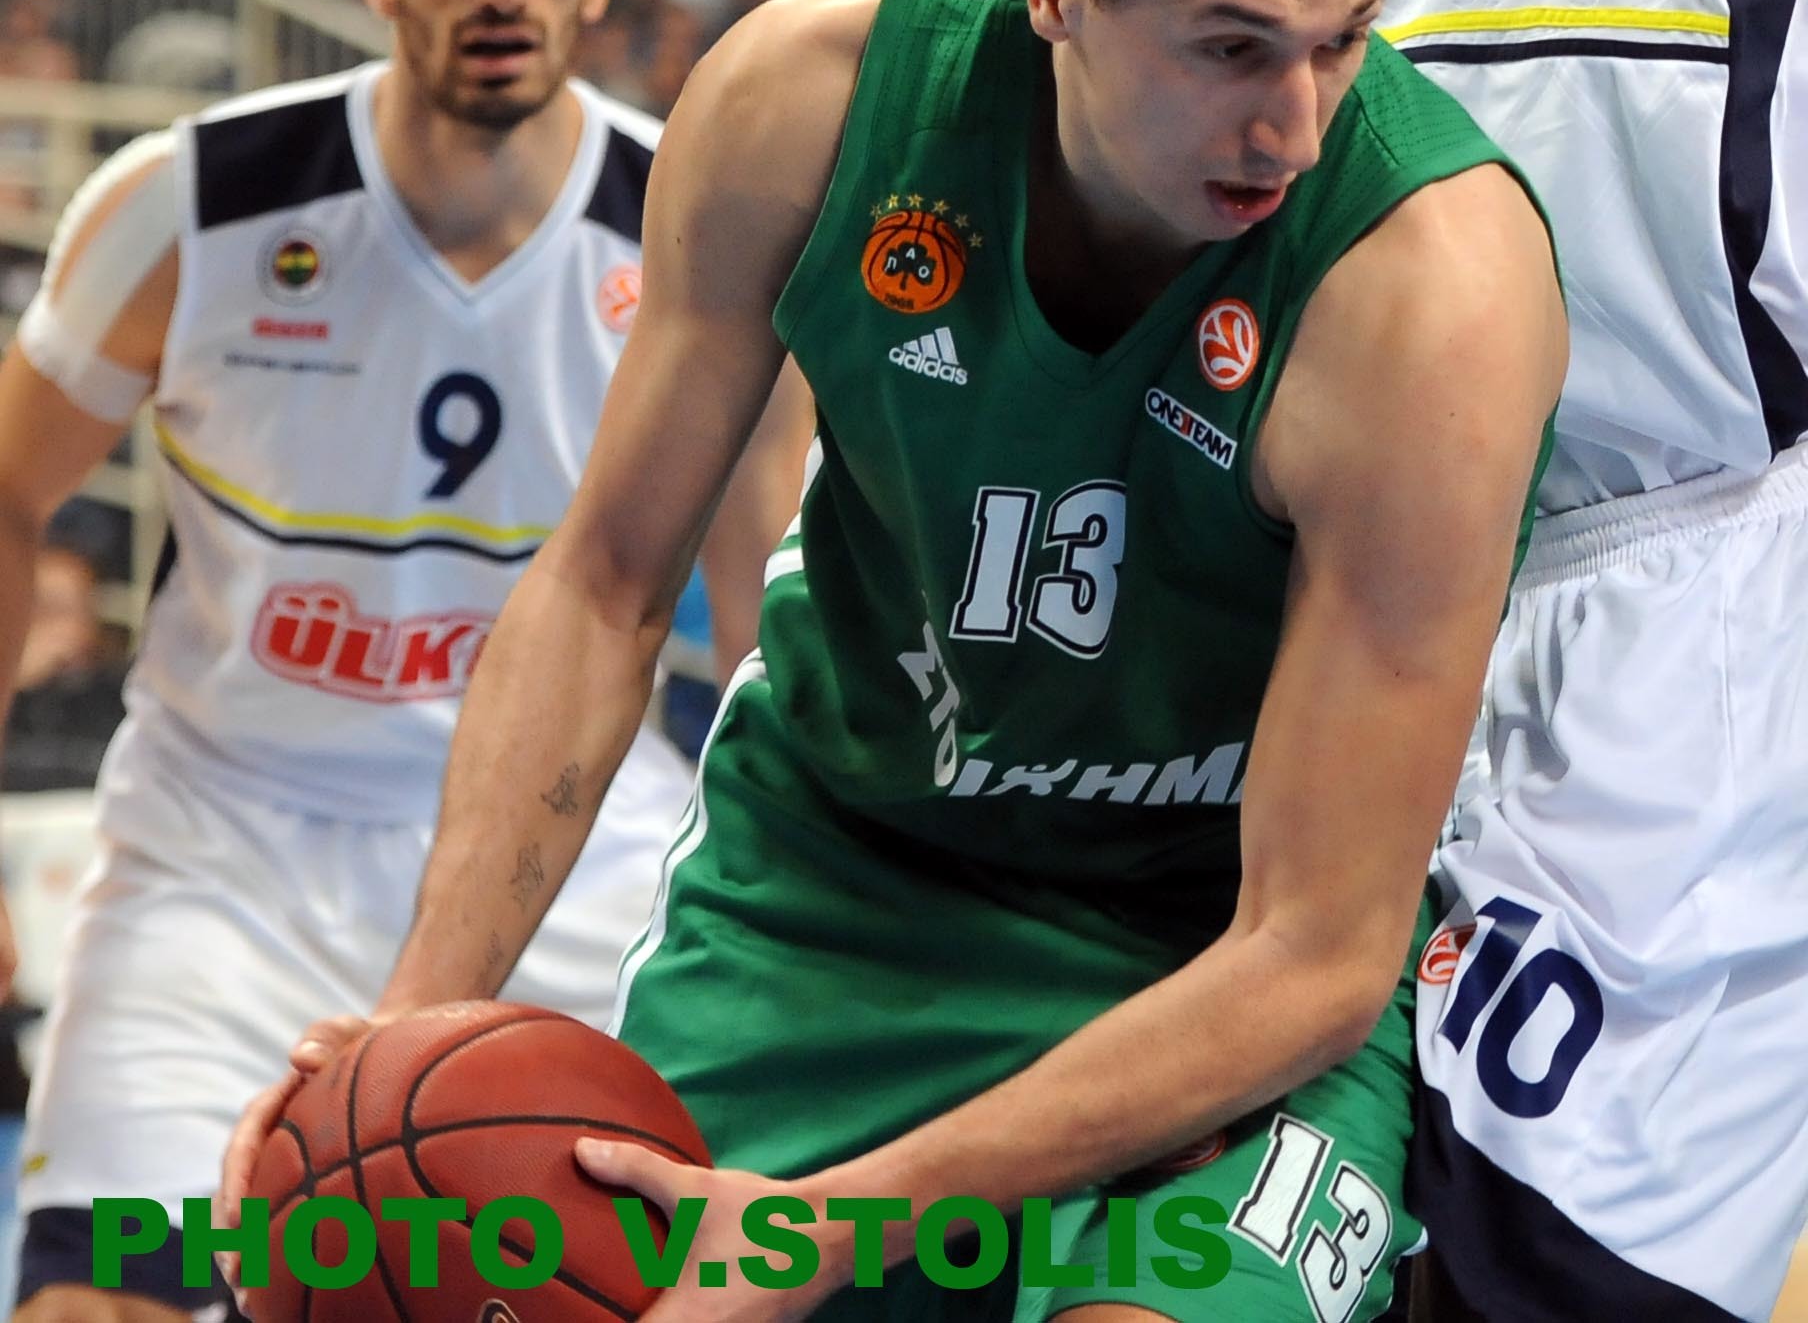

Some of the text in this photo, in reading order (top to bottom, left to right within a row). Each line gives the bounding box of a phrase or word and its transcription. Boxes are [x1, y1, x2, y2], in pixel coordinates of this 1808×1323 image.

[418, 371, 503, 501] 9
[888, 345, 969, 386] adidas
[261, 588, 488, 695] ÜLK
[948, 479, 1127, 661] 13
[1436, 895, 1605, 1120] 10
[1225, 1111, 1394, 1323] 13
